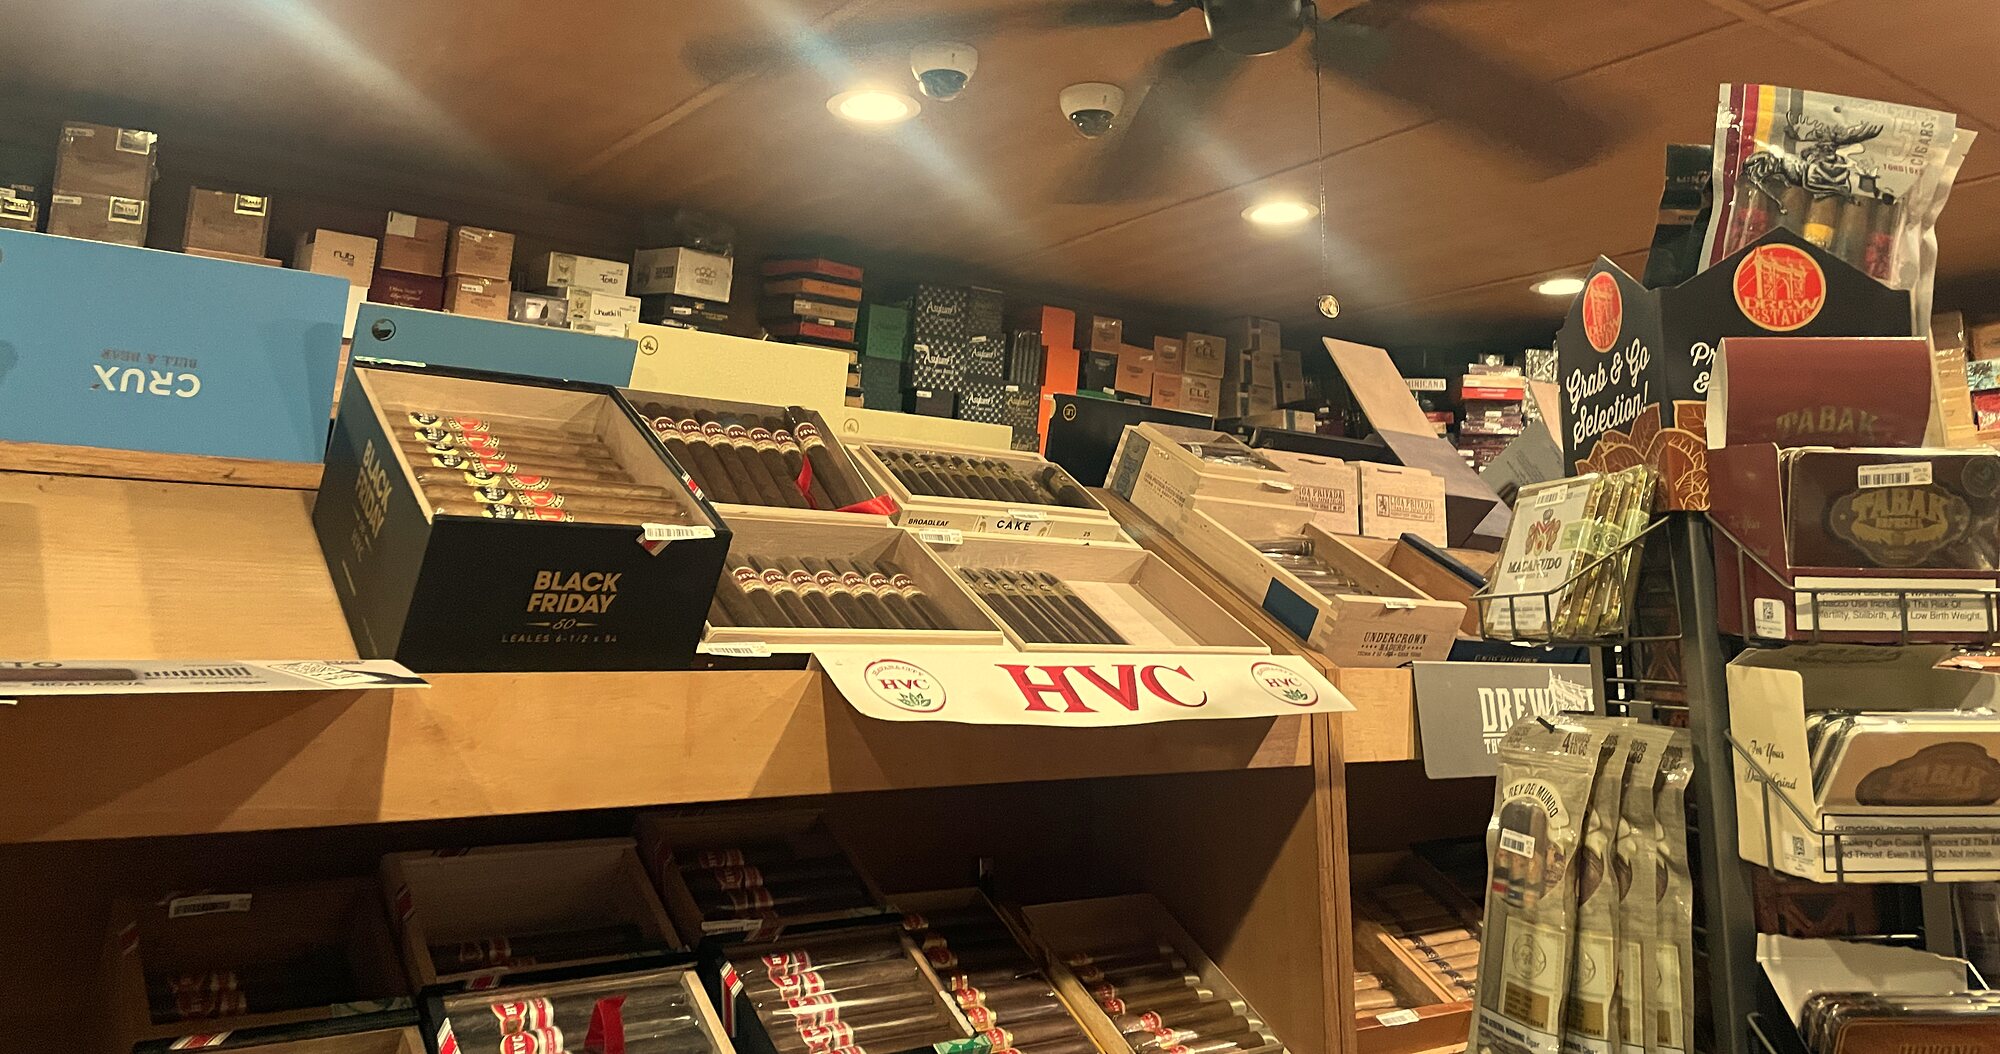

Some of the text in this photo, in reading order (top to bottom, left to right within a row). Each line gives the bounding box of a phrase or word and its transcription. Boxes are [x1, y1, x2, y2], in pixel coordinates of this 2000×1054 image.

[1743, 296, 1821, 310] DREW
[1752, 308, 1809, 325] ESTATE
[93, 364, 201, 398] CRUX
[1566, 338, 1650, 414] Grab & Go
[1573, 380, 1650, 450] Selection!
[1776, 404, 1878, 435] TABAK
[363, 439, 393, 514] BLACK
[355, 466, 385, 540] FRIDAY
[1851, 487, 1948, 520] TABAK
[908, 518, 950, 527] BROADLEAF
[996, 519, 1032, 531] CAKE
[533, 570, 623, 592] BLACK
[527, 592, 617, 613] FRIDAY
[1910, 612, 1927, 620] Low
[1930, 612, 1950, 620] Birth
[1363, 632, 1428, 645] UNDERCROWN
[877, 679, 930, 690] HVC
[994, 664, 1208, 713] HVC
[1265, 678, 1302, 687] HVC
[1562, 733, 1572, 753] 4
[1508, 782, 1559, 818] REY DEL MUNDO
